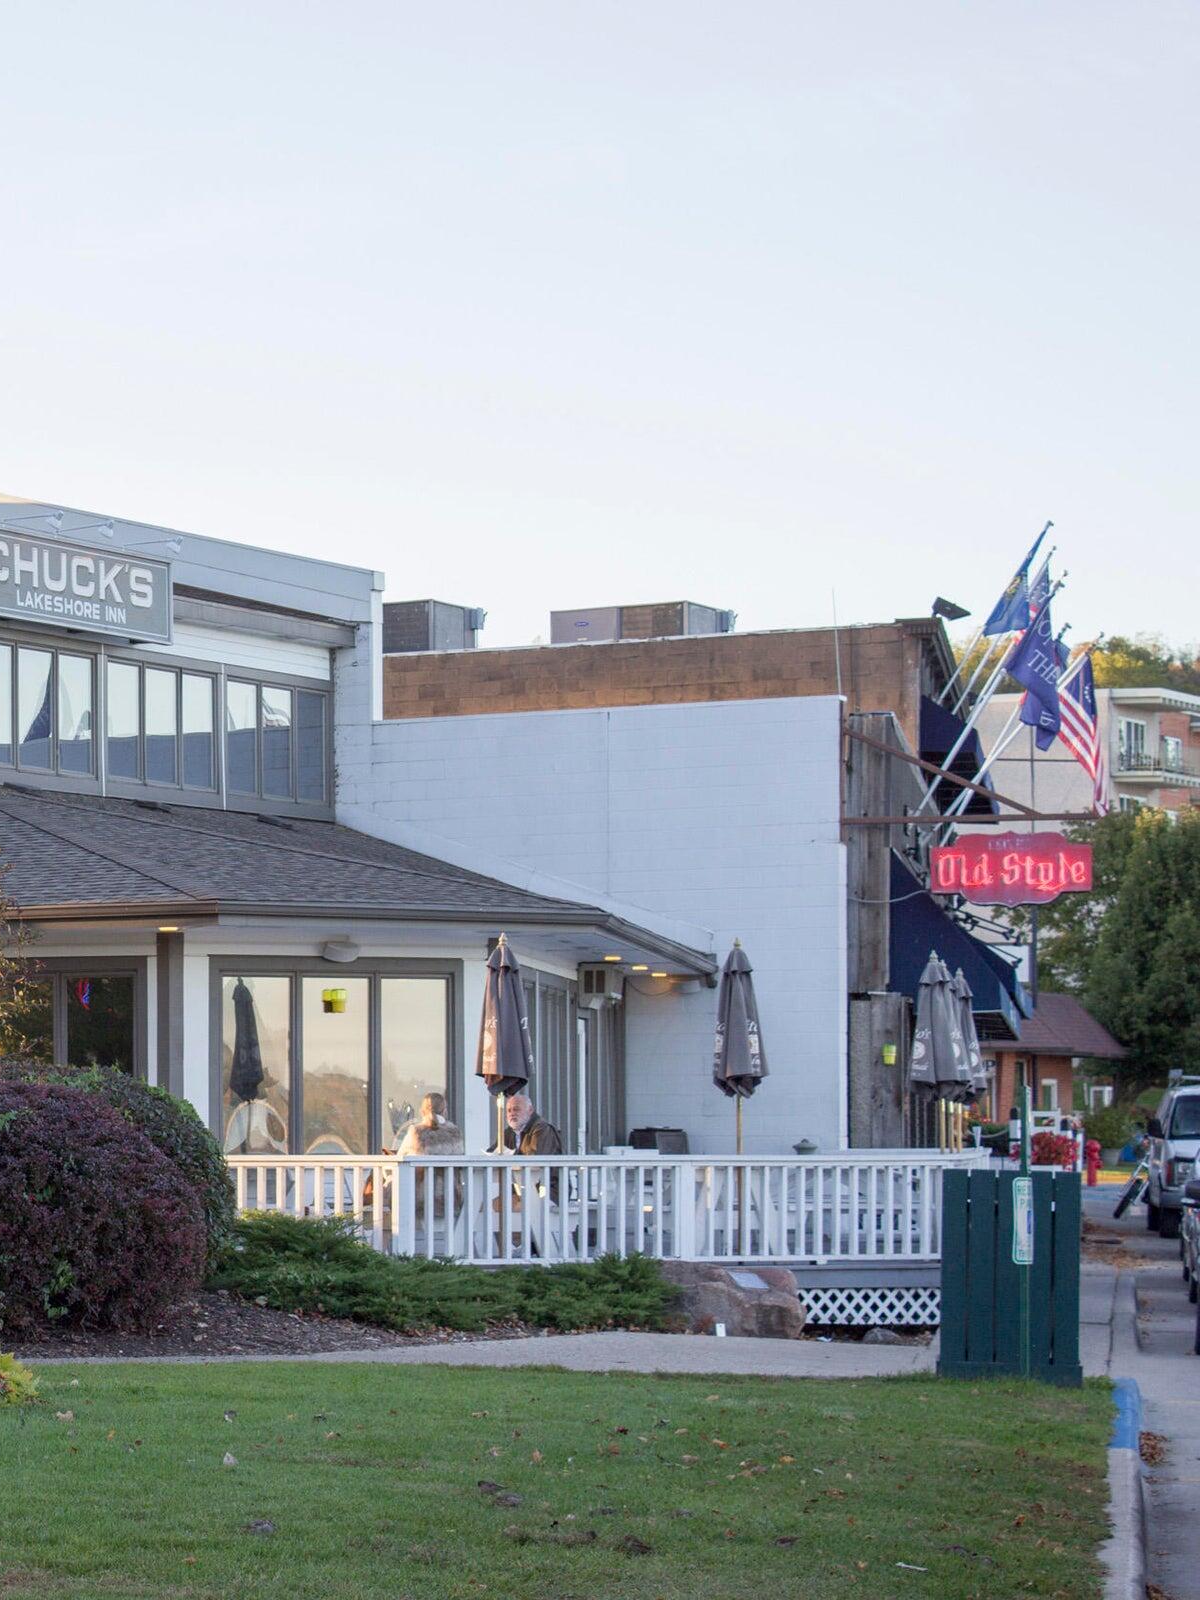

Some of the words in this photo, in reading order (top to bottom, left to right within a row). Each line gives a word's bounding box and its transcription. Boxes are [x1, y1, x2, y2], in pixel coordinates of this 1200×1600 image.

[16, 590, 101, 619] LAKESHORE
[105, 606, 126, 624] INN
[938, 853, 994, 887] Old
[1001, 852, 1086, 890] Style
